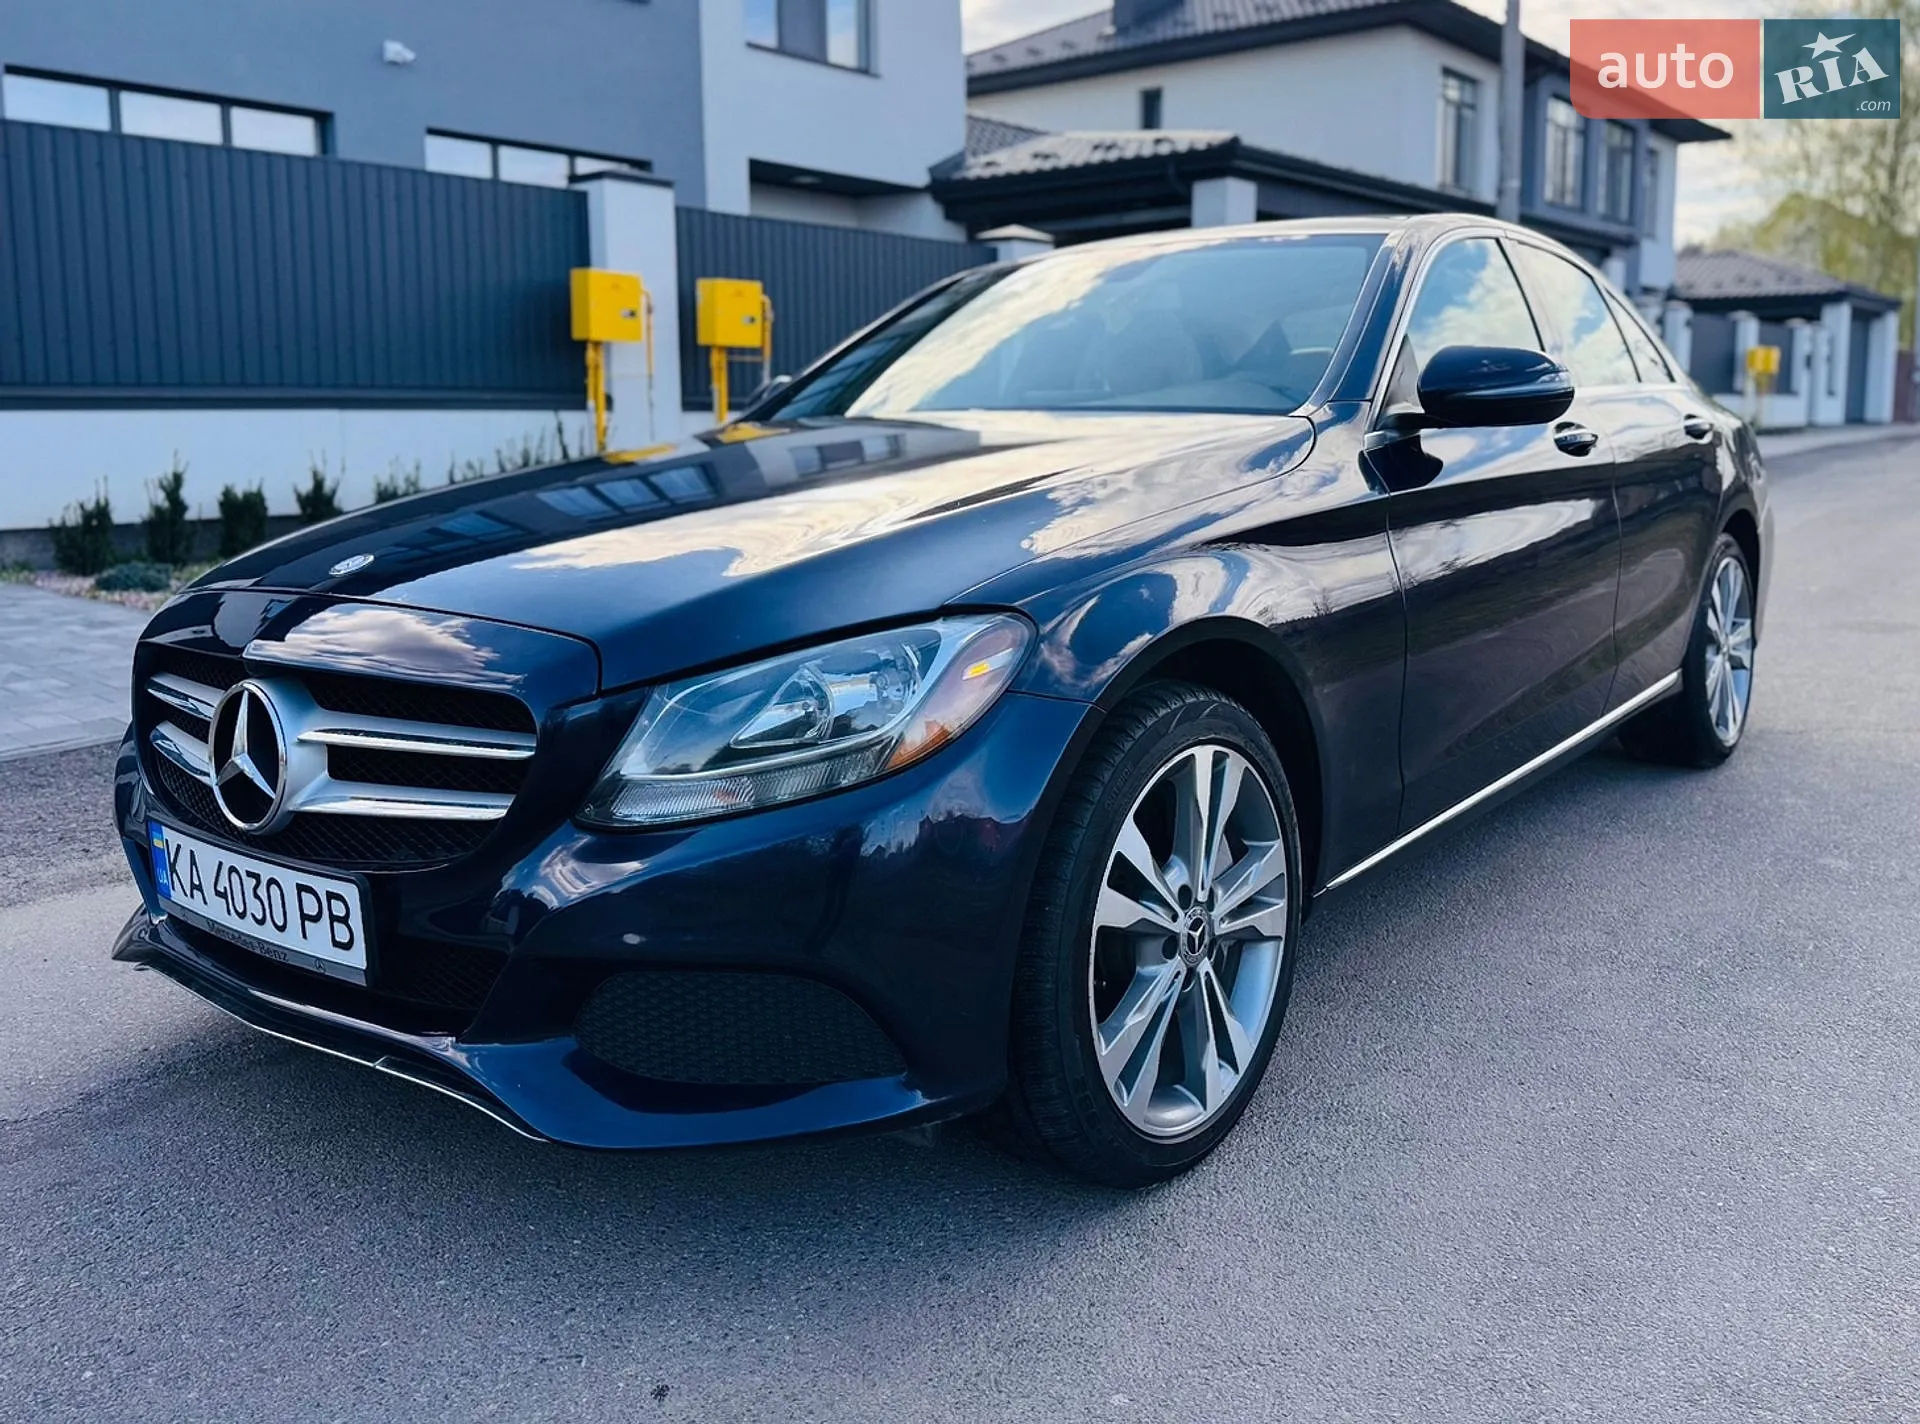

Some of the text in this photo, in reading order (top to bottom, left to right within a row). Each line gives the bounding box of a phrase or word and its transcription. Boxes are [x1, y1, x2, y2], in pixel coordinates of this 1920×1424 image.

[158, 869, 169, 887] UA
[165, 838, 355, 951] KA 4030 PB
